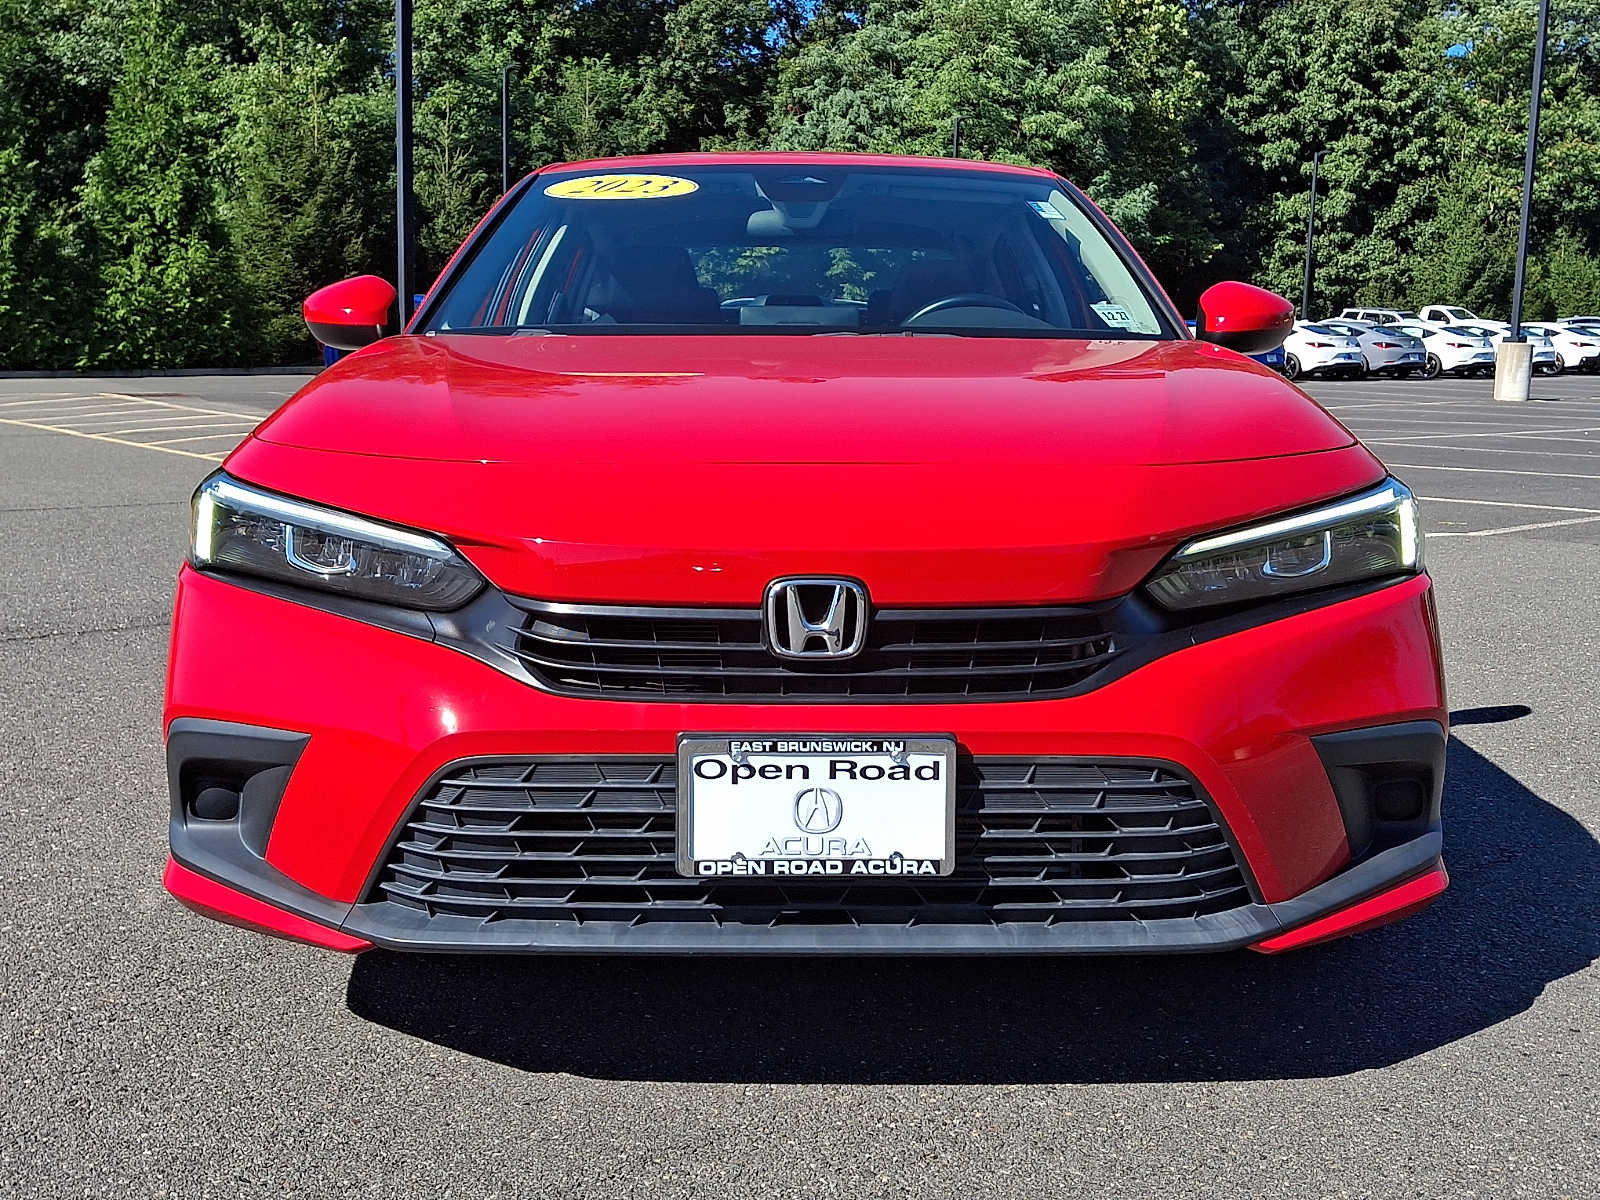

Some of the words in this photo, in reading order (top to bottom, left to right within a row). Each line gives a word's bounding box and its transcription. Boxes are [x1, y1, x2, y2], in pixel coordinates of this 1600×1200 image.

[568, 179, 680, 194] 2023
[730, 741, 773, 752] EAST
[777, 741, 878, 753] BRUNSWICK,
[882, 741, 904, 752] NJ
[693, 758, 810, 785] Open
[828, 759, 941, 781] Road
[759, 836, 873, 856] ACURA
[698, 860, 766, 875] OPEN
[773, 860, 843, 875] ROAD
[850, 860, 937, 875] ACURA
